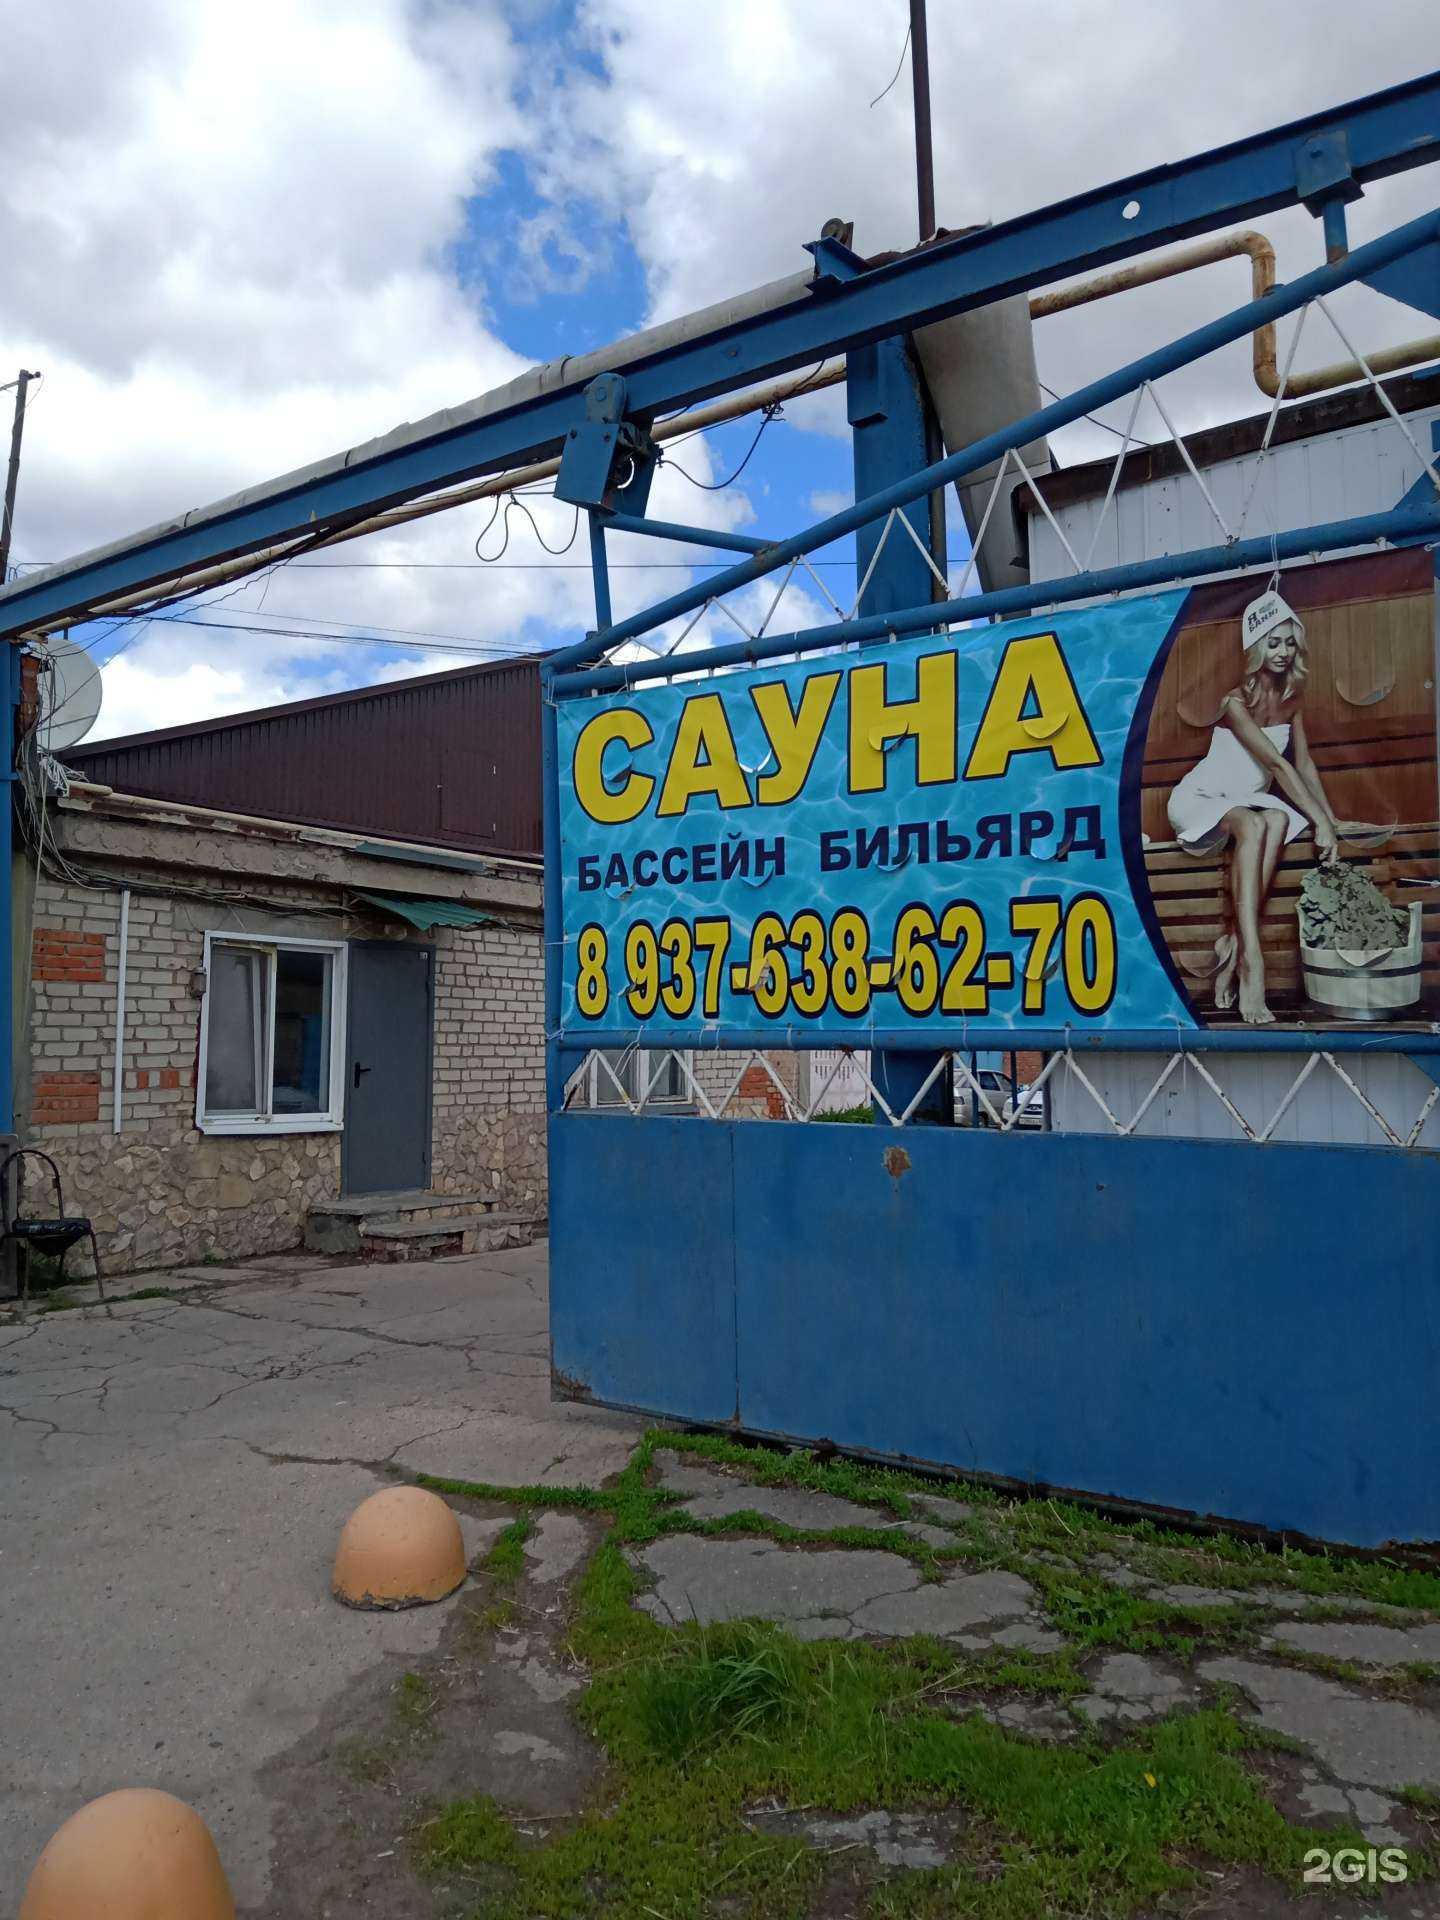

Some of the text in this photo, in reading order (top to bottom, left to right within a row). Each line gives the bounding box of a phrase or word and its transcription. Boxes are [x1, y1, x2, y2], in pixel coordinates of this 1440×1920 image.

[572, 631, 1104, 825] САУНА
[578, 805, 1107, 892] БАССЕЙН БИЛЬЯРД
[576, 891, 1118, 1019] 8 937-638-62-70
